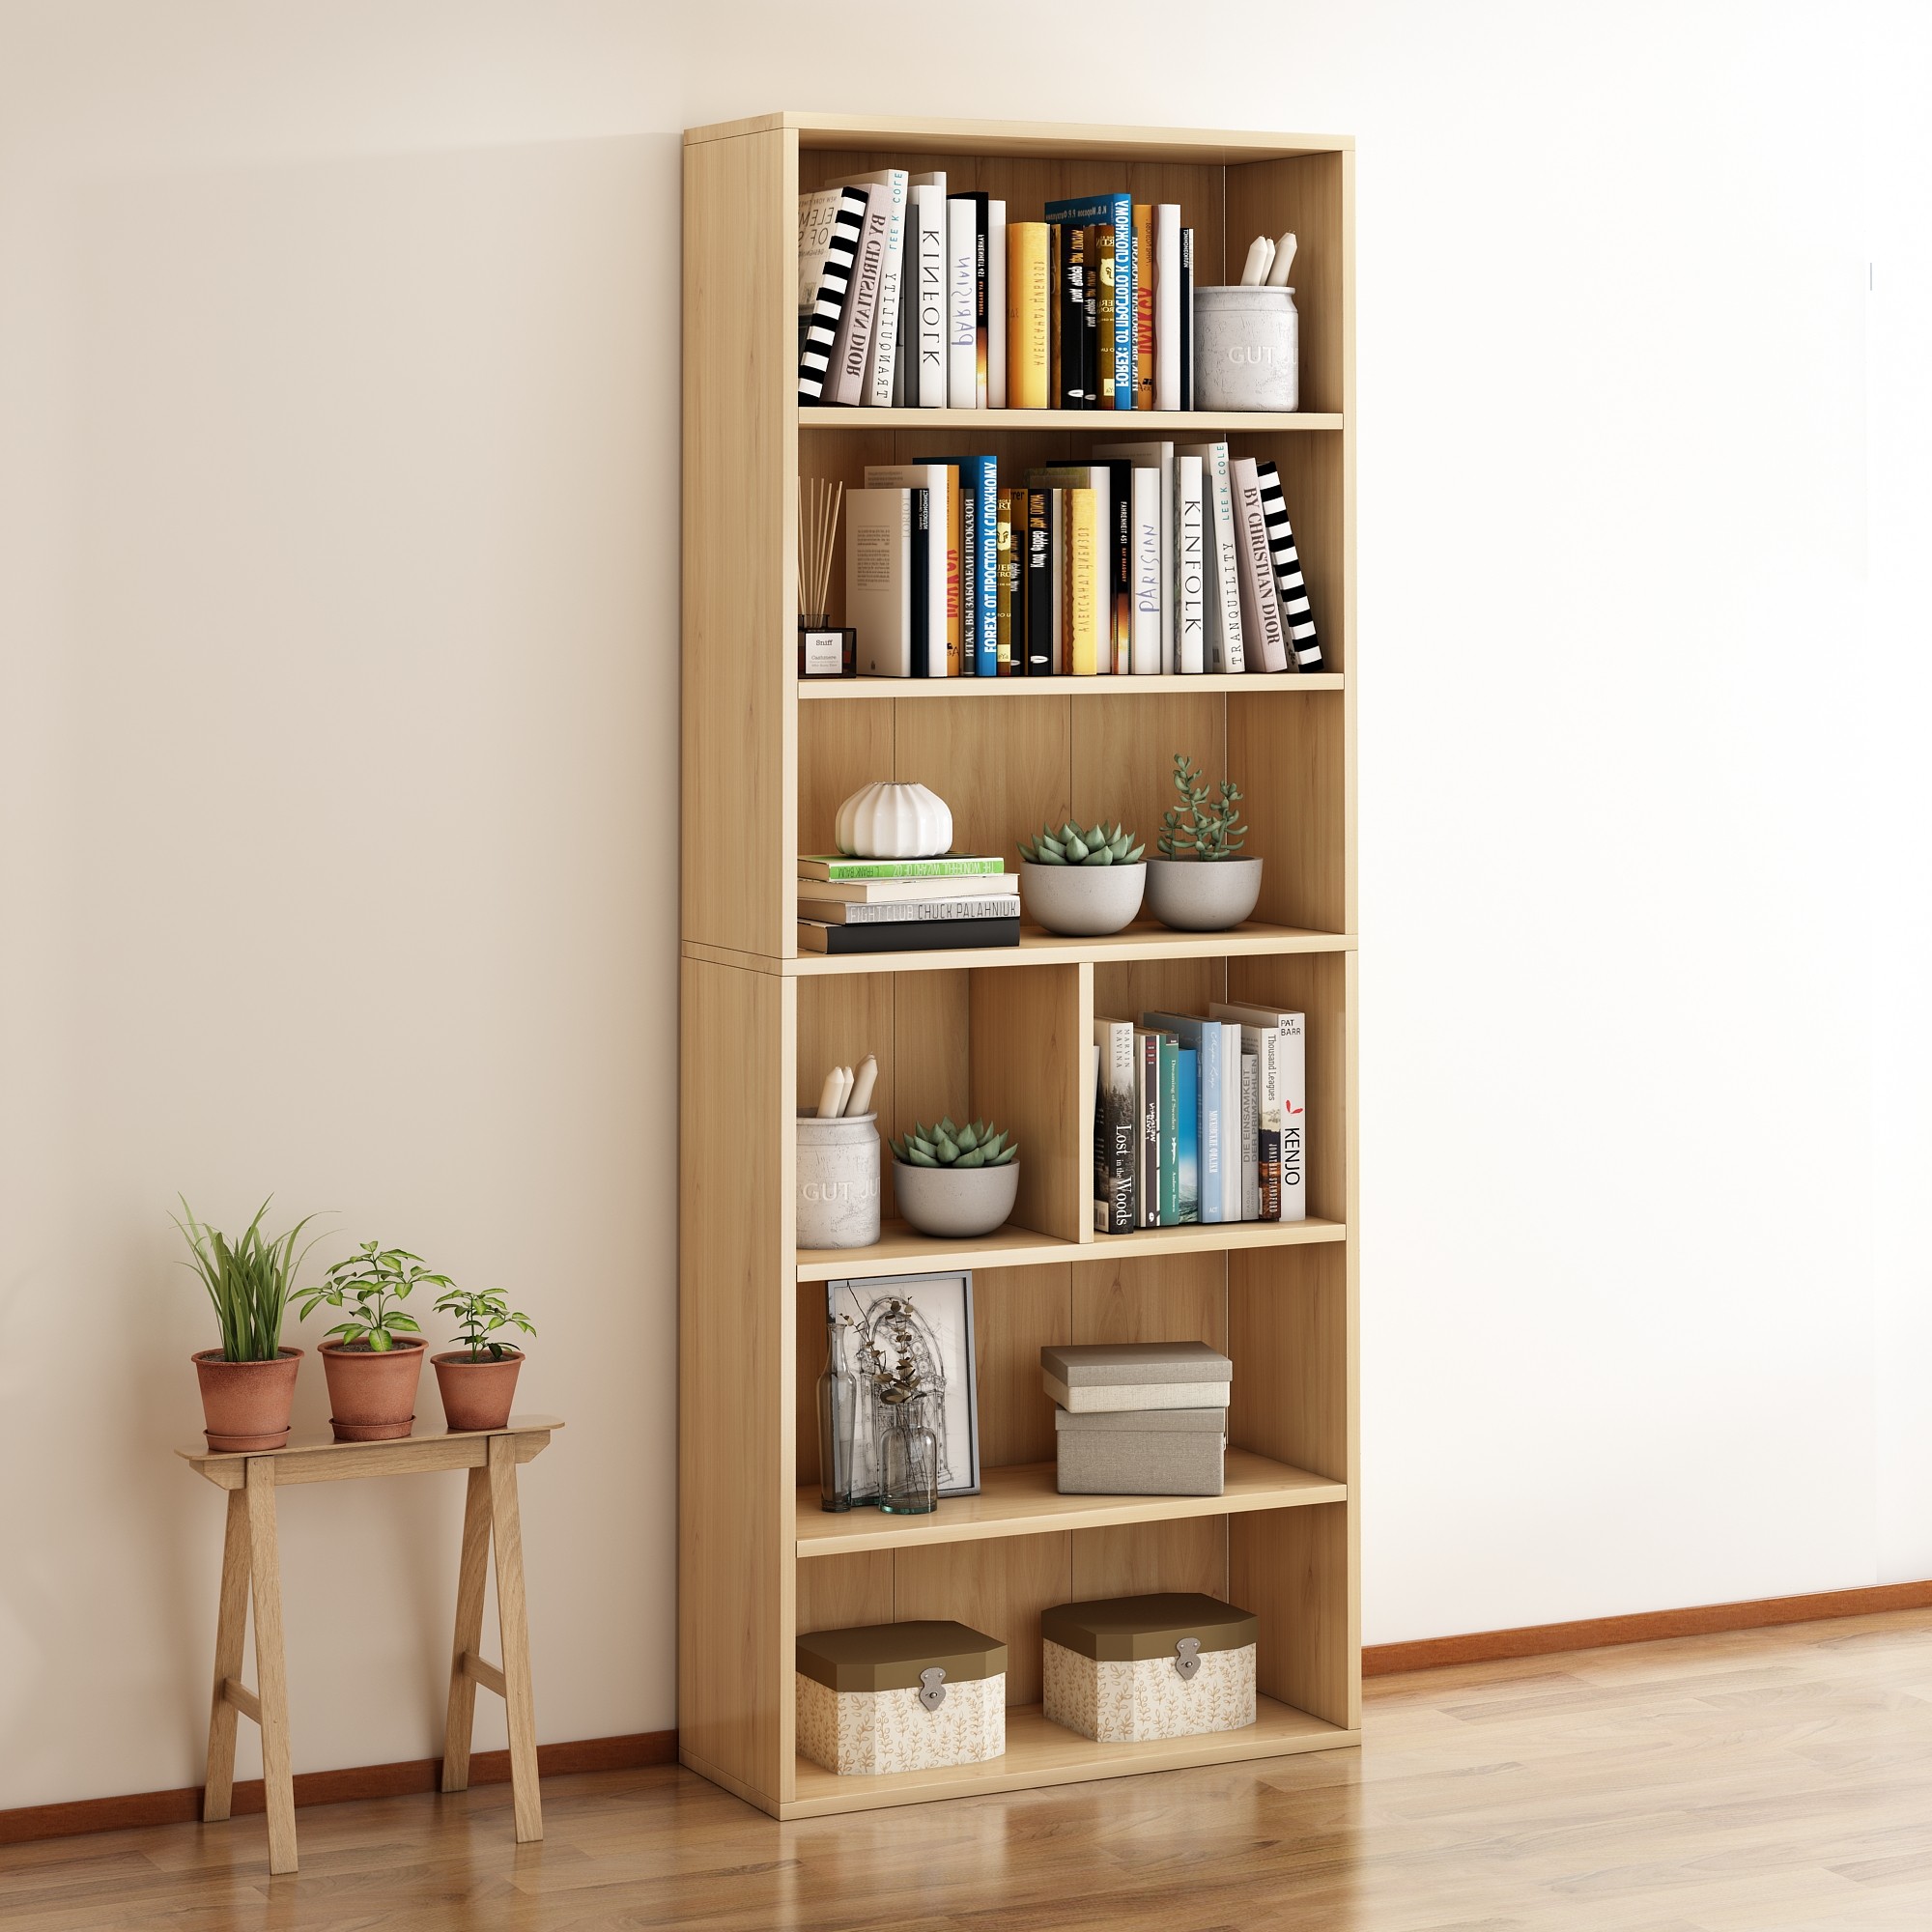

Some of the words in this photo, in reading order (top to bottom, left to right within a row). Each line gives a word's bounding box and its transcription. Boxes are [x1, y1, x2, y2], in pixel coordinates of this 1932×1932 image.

[1228, 346, 1276, 364] GUT
[1216, 445, 1225, 475] COLE
[984, 462, 996, 526] СЛОЖНОМУ
[1244, 487, 1259, 508] BY
[964, 498, 974, 553] ПРОКАЗОЙ
[984, 528, 996, 536] К
[1030, 531, 1049, 551] Фаррер
[984, 539, 996, 592] ПРОСТОГО
[1030, 554, 1047, 568] Клод
[1136, 525, 1159, 612] PARISIAN
[1185, 500, 1201, 634] KINFOLK
[1247, 512, 1273, 599] CHRISTIAN
[965, 555, 974, 609] ЗАБОЛЕЛИ
[984, 594, 996, 608] ОТ
[1223, 543, 1242, 665] TRANQUILITY
[965, 611, 974, 625] ВЫ
[984, 612, 996, 653] FOREX:
[1262, 600, 1280, 646] DIOR
[965, 627, 975, 657] ИТАК,
[838, 867, 854, 878] BAUM
[855, 867, 874, 878] FRANK
[850, 906, 882, 923] FIGHT
[886, 904, 913, 920] CLUB
[918, 903, 952, 919] CHUCK
[957, 901, 1017, 918] PALAHNIUK
[1281, 1028, 1301, 1036] BARR
[1268, 1035, 1276, 1070] Thousand
[1266, 1072, 1276, 1101] Leagues
[1116, 1124, 1132, 1156] Lost
[1269, 1143, 1277, 1176] JONATHAN
[1285, 1128, 1300, 1186] KENJO
[802, 1181, 853, 1201] GUT
[1116, 1176, 1132, 1225] Woods
